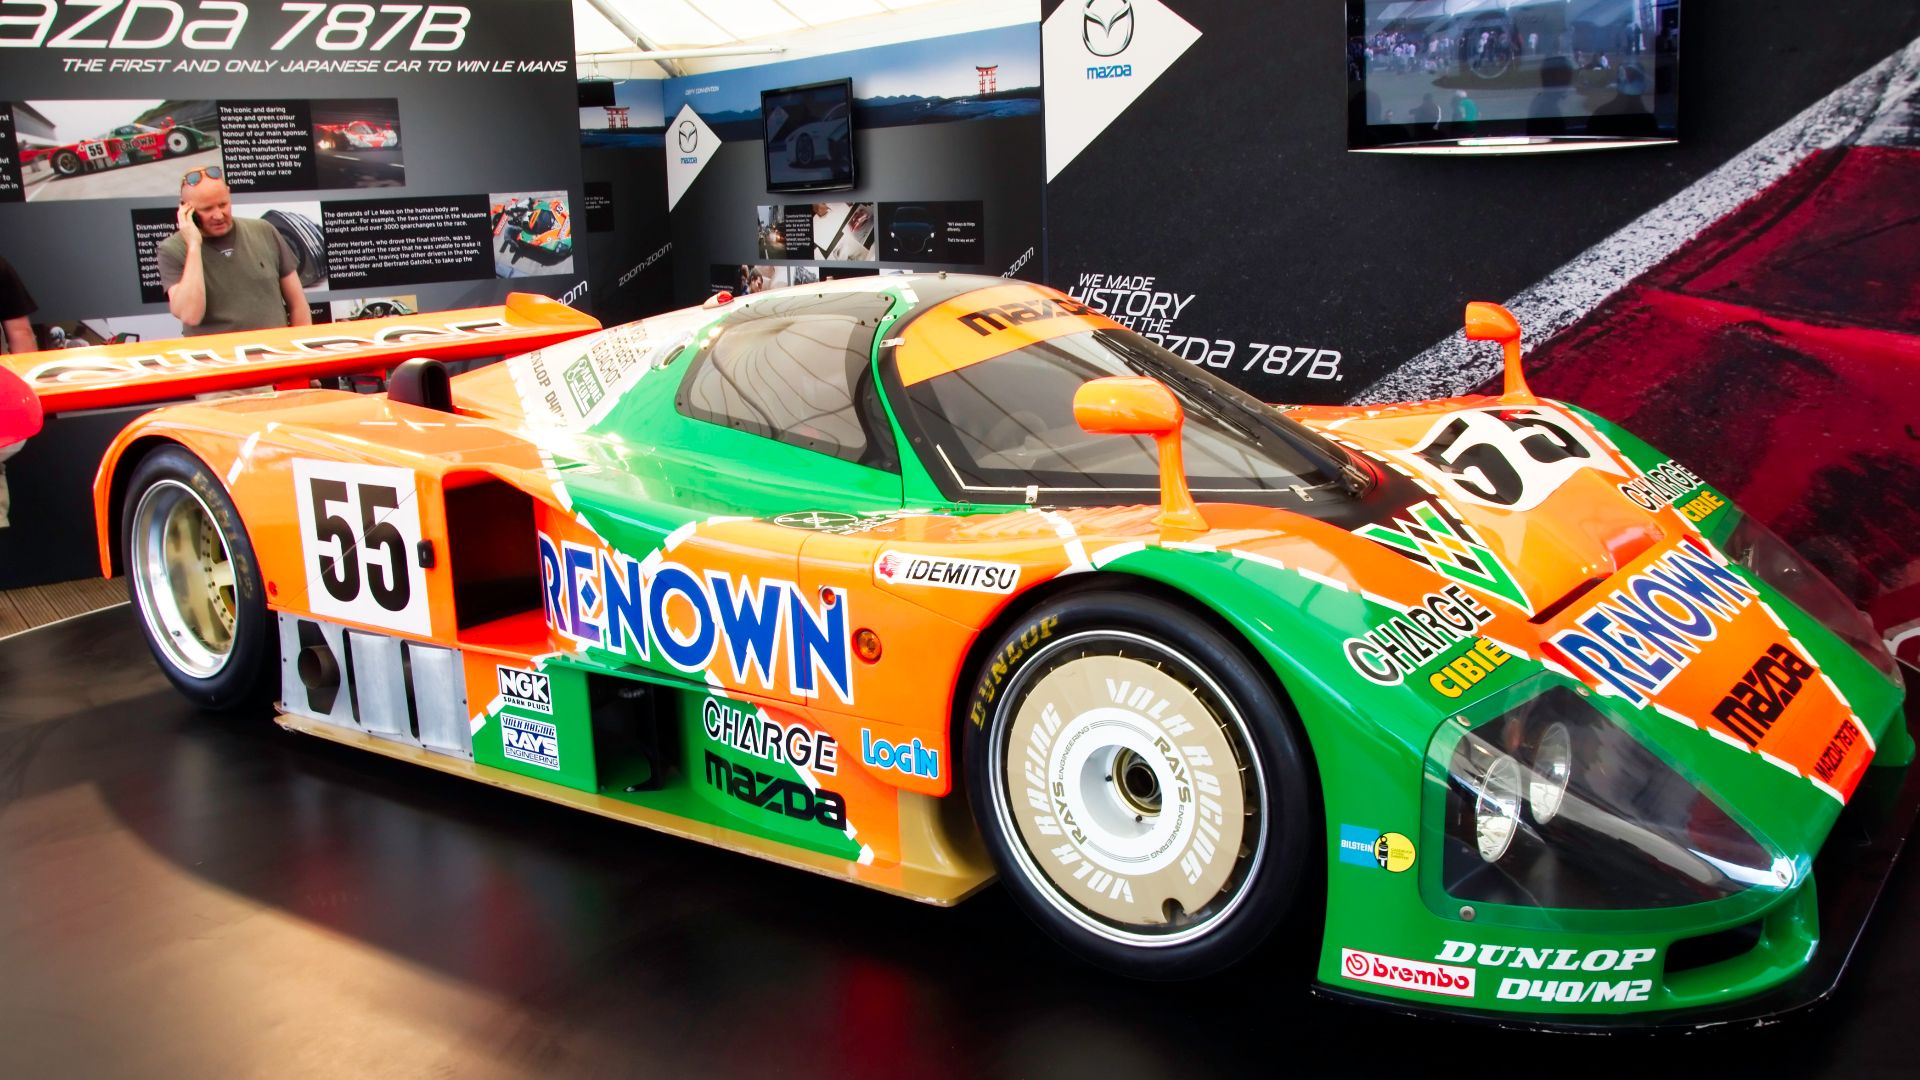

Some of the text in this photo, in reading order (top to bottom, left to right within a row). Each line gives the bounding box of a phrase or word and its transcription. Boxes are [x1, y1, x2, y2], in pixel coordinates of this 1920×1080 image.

[271, 2, 472, 52] 787B
[63, 58, 569, 73] THE FIRST AND ONLY JAPANESE CAR TO WIN LE MANS
[618, 242, 673, 287] zoom-zoom
[1079, 273, 1156, 292] WE MADE
[1067, 286, 1196, 320] HISTORY
[1140, 317, 1173, 334] THE
[1242, 343, 1344, 382] 787B.
[1416, 410, 1591, 507] 55
[1622, 461, 1704, 513] CHARGE
[309, 477, 411, 612] 55
[905, 558, 1018, 592] IDEMITSU
[539, 532, 854, 706] RENOWN
[1344, 584, 1495, 686] CHARGE
[1549, 540, 1759, 710] RENOWN
[500, 669, 550, 704] NGK
[970, 614, 1059, 732] DUNLOP
[1711, 643, 1815, 747] mazda
[503, 696, 550, 712] SPARK PLUGS
[504, 728, 557, 756] RAYS
[505, 748, 558, 766] ENGINEERING
[704, 696, 838, 776] CHARGE
[1813, 719, 1860, 783] MAZDA 787B
[705, 750, 847, 832] mazda
[1026, 702, 1135, 905] VOLK RACING
[1053, 725, 1091, 846] RAYS ENGINEERING
[1105, 678, 1224, 886] VOLK RACING
[1150, 736, 1193, 860] RAYS ENGINEERING
[1340, 839, 1374, 854] BILSTEIN
[1372, 957, 1471, 992] brembo
[1434, 940, 1657, 972] DUNLOP
[1496, 978, 1654, 1004] D40/M2
